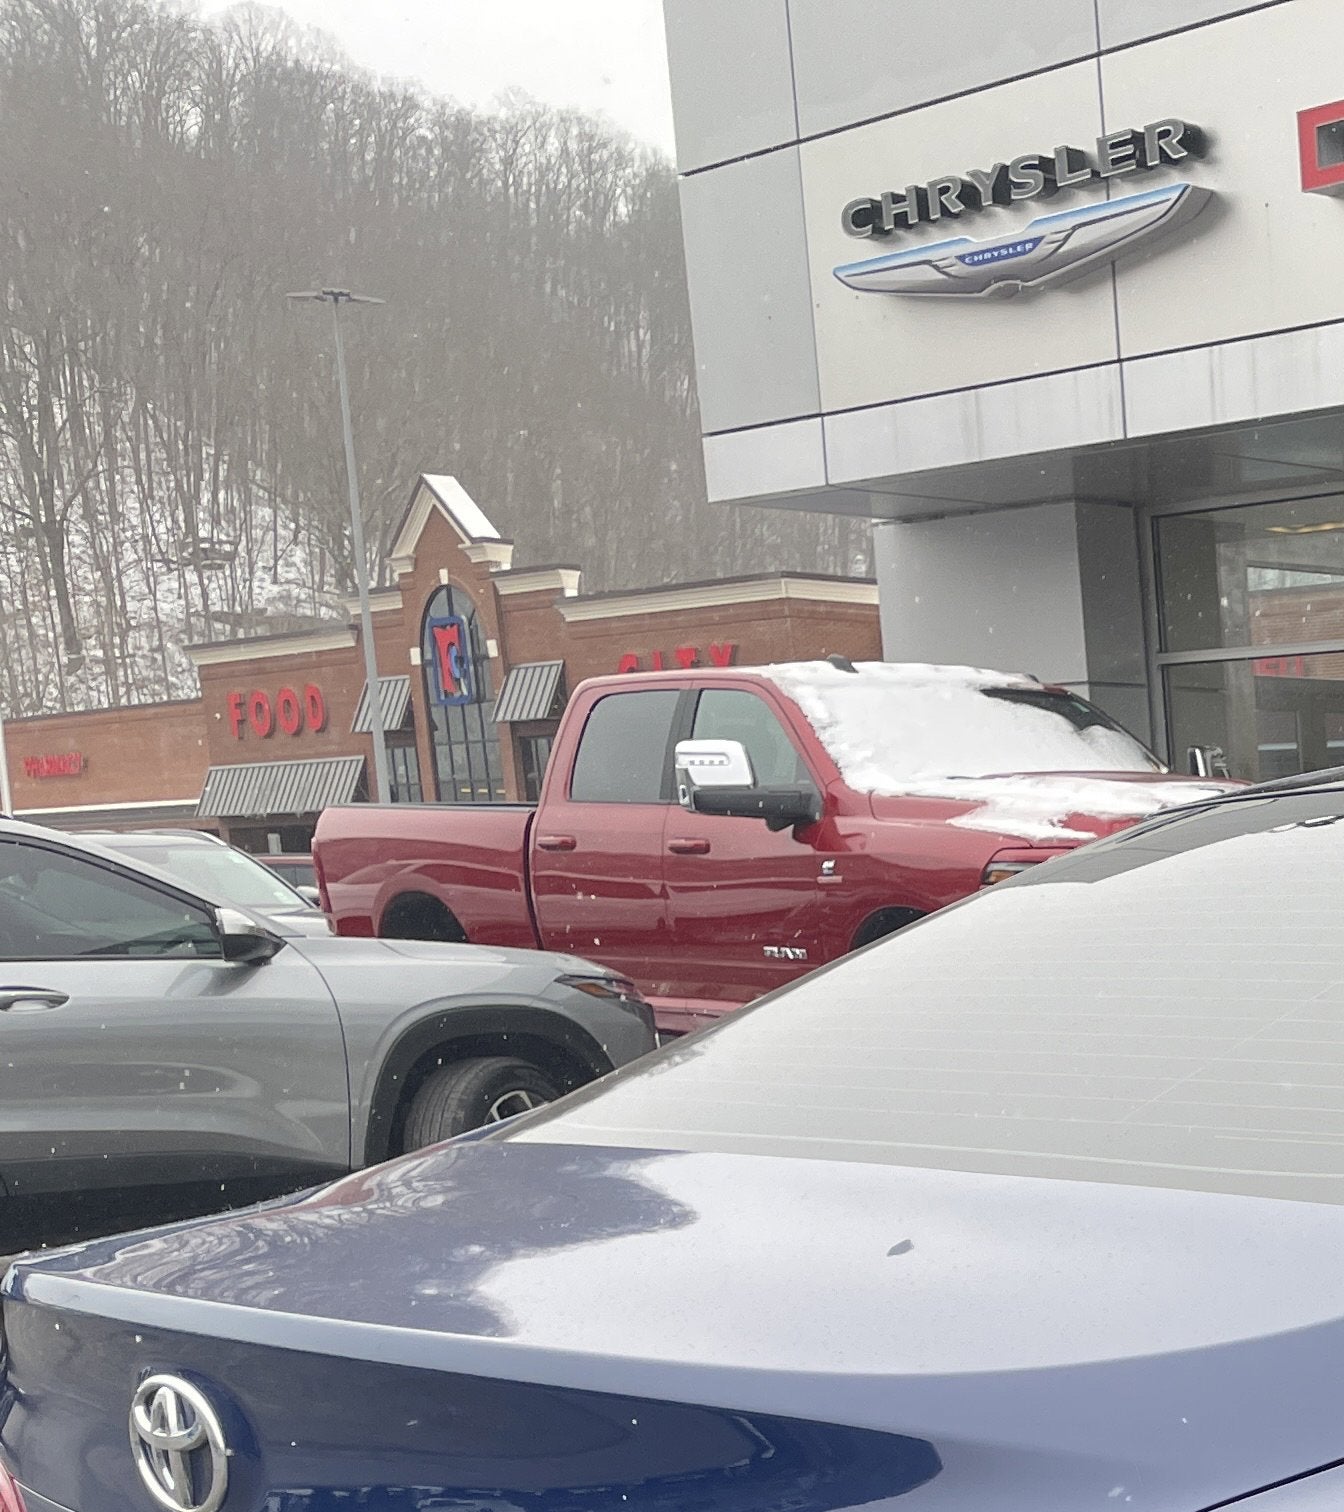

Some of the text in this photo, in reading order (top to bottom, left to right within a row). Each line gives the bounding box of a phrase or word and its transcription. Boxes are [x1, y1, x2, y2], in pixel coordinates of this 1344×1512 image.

[841, 118, 1195, 238] CHRYSLER
[964, 242, 1034, 264] CHRYSLER
[226, 682, 326, 738] FOOD
